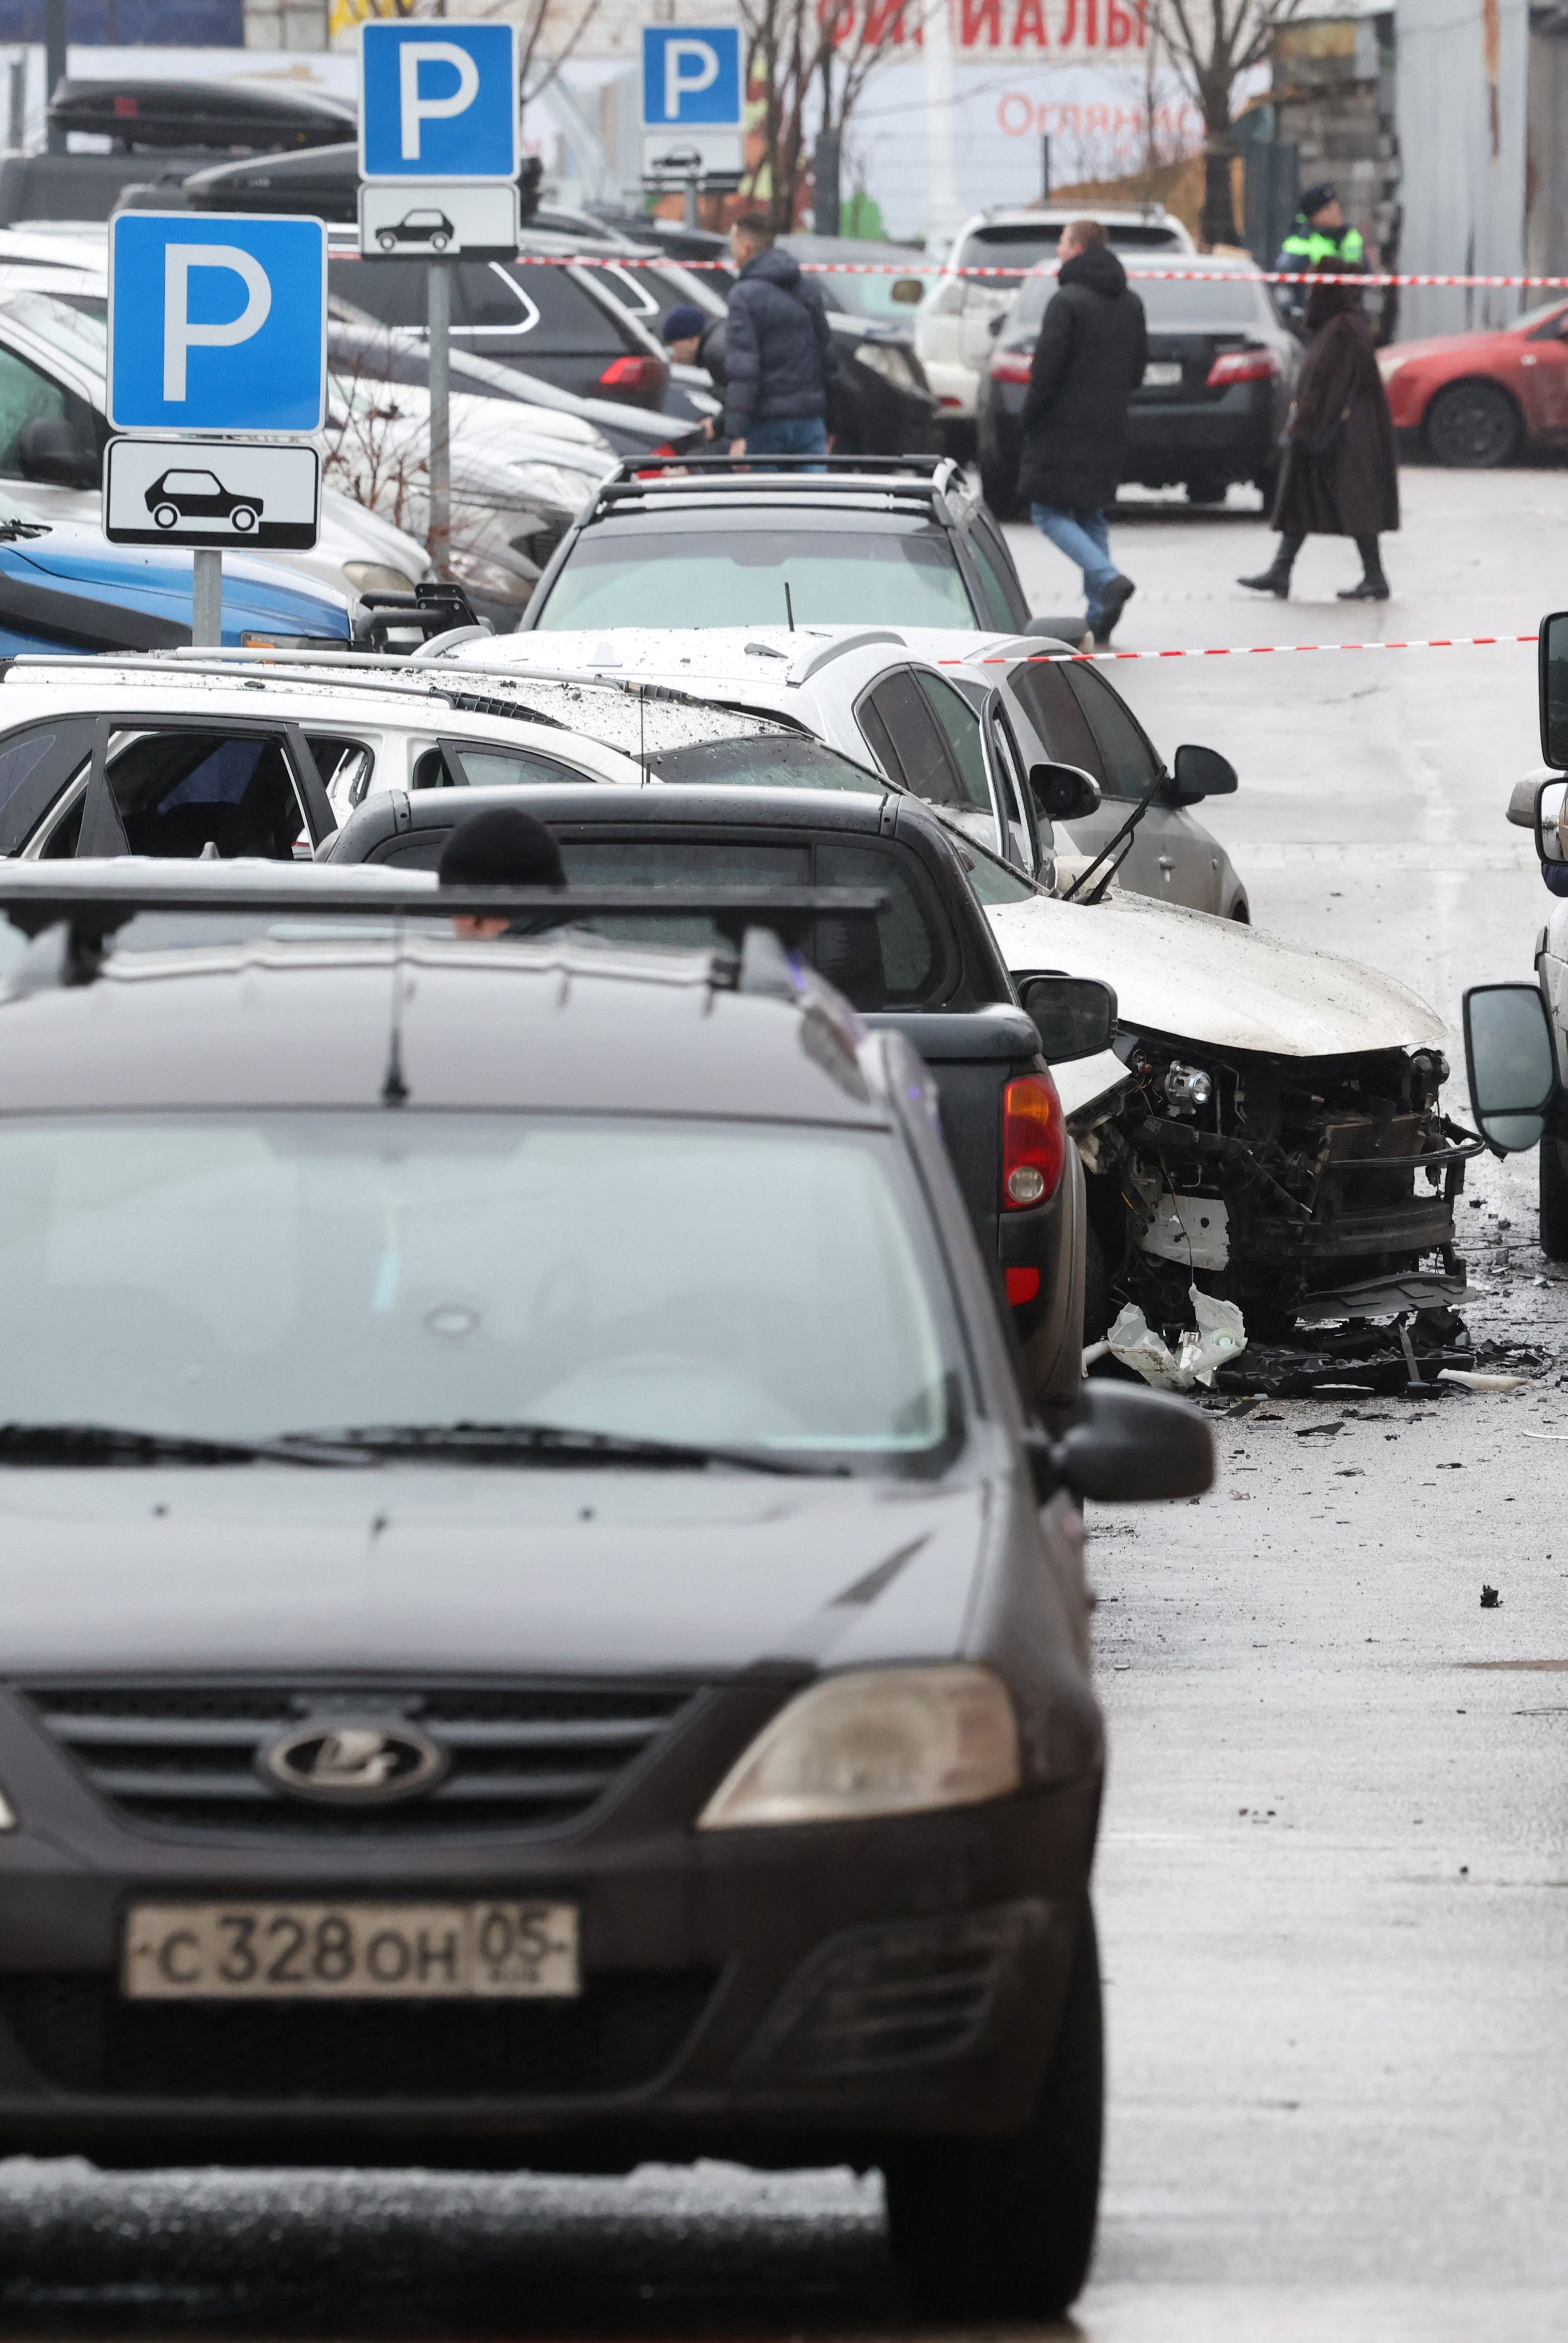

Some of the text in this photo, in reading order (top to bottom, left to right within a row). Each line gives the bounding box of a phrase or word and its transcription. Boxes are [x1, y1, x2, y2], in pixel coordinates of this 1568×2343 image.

[399, 42, 480, 160] P
[664, 39, 720, 119] P
[163, 243, 272, 402] P
[479, 1911, 550, 1963] 05
